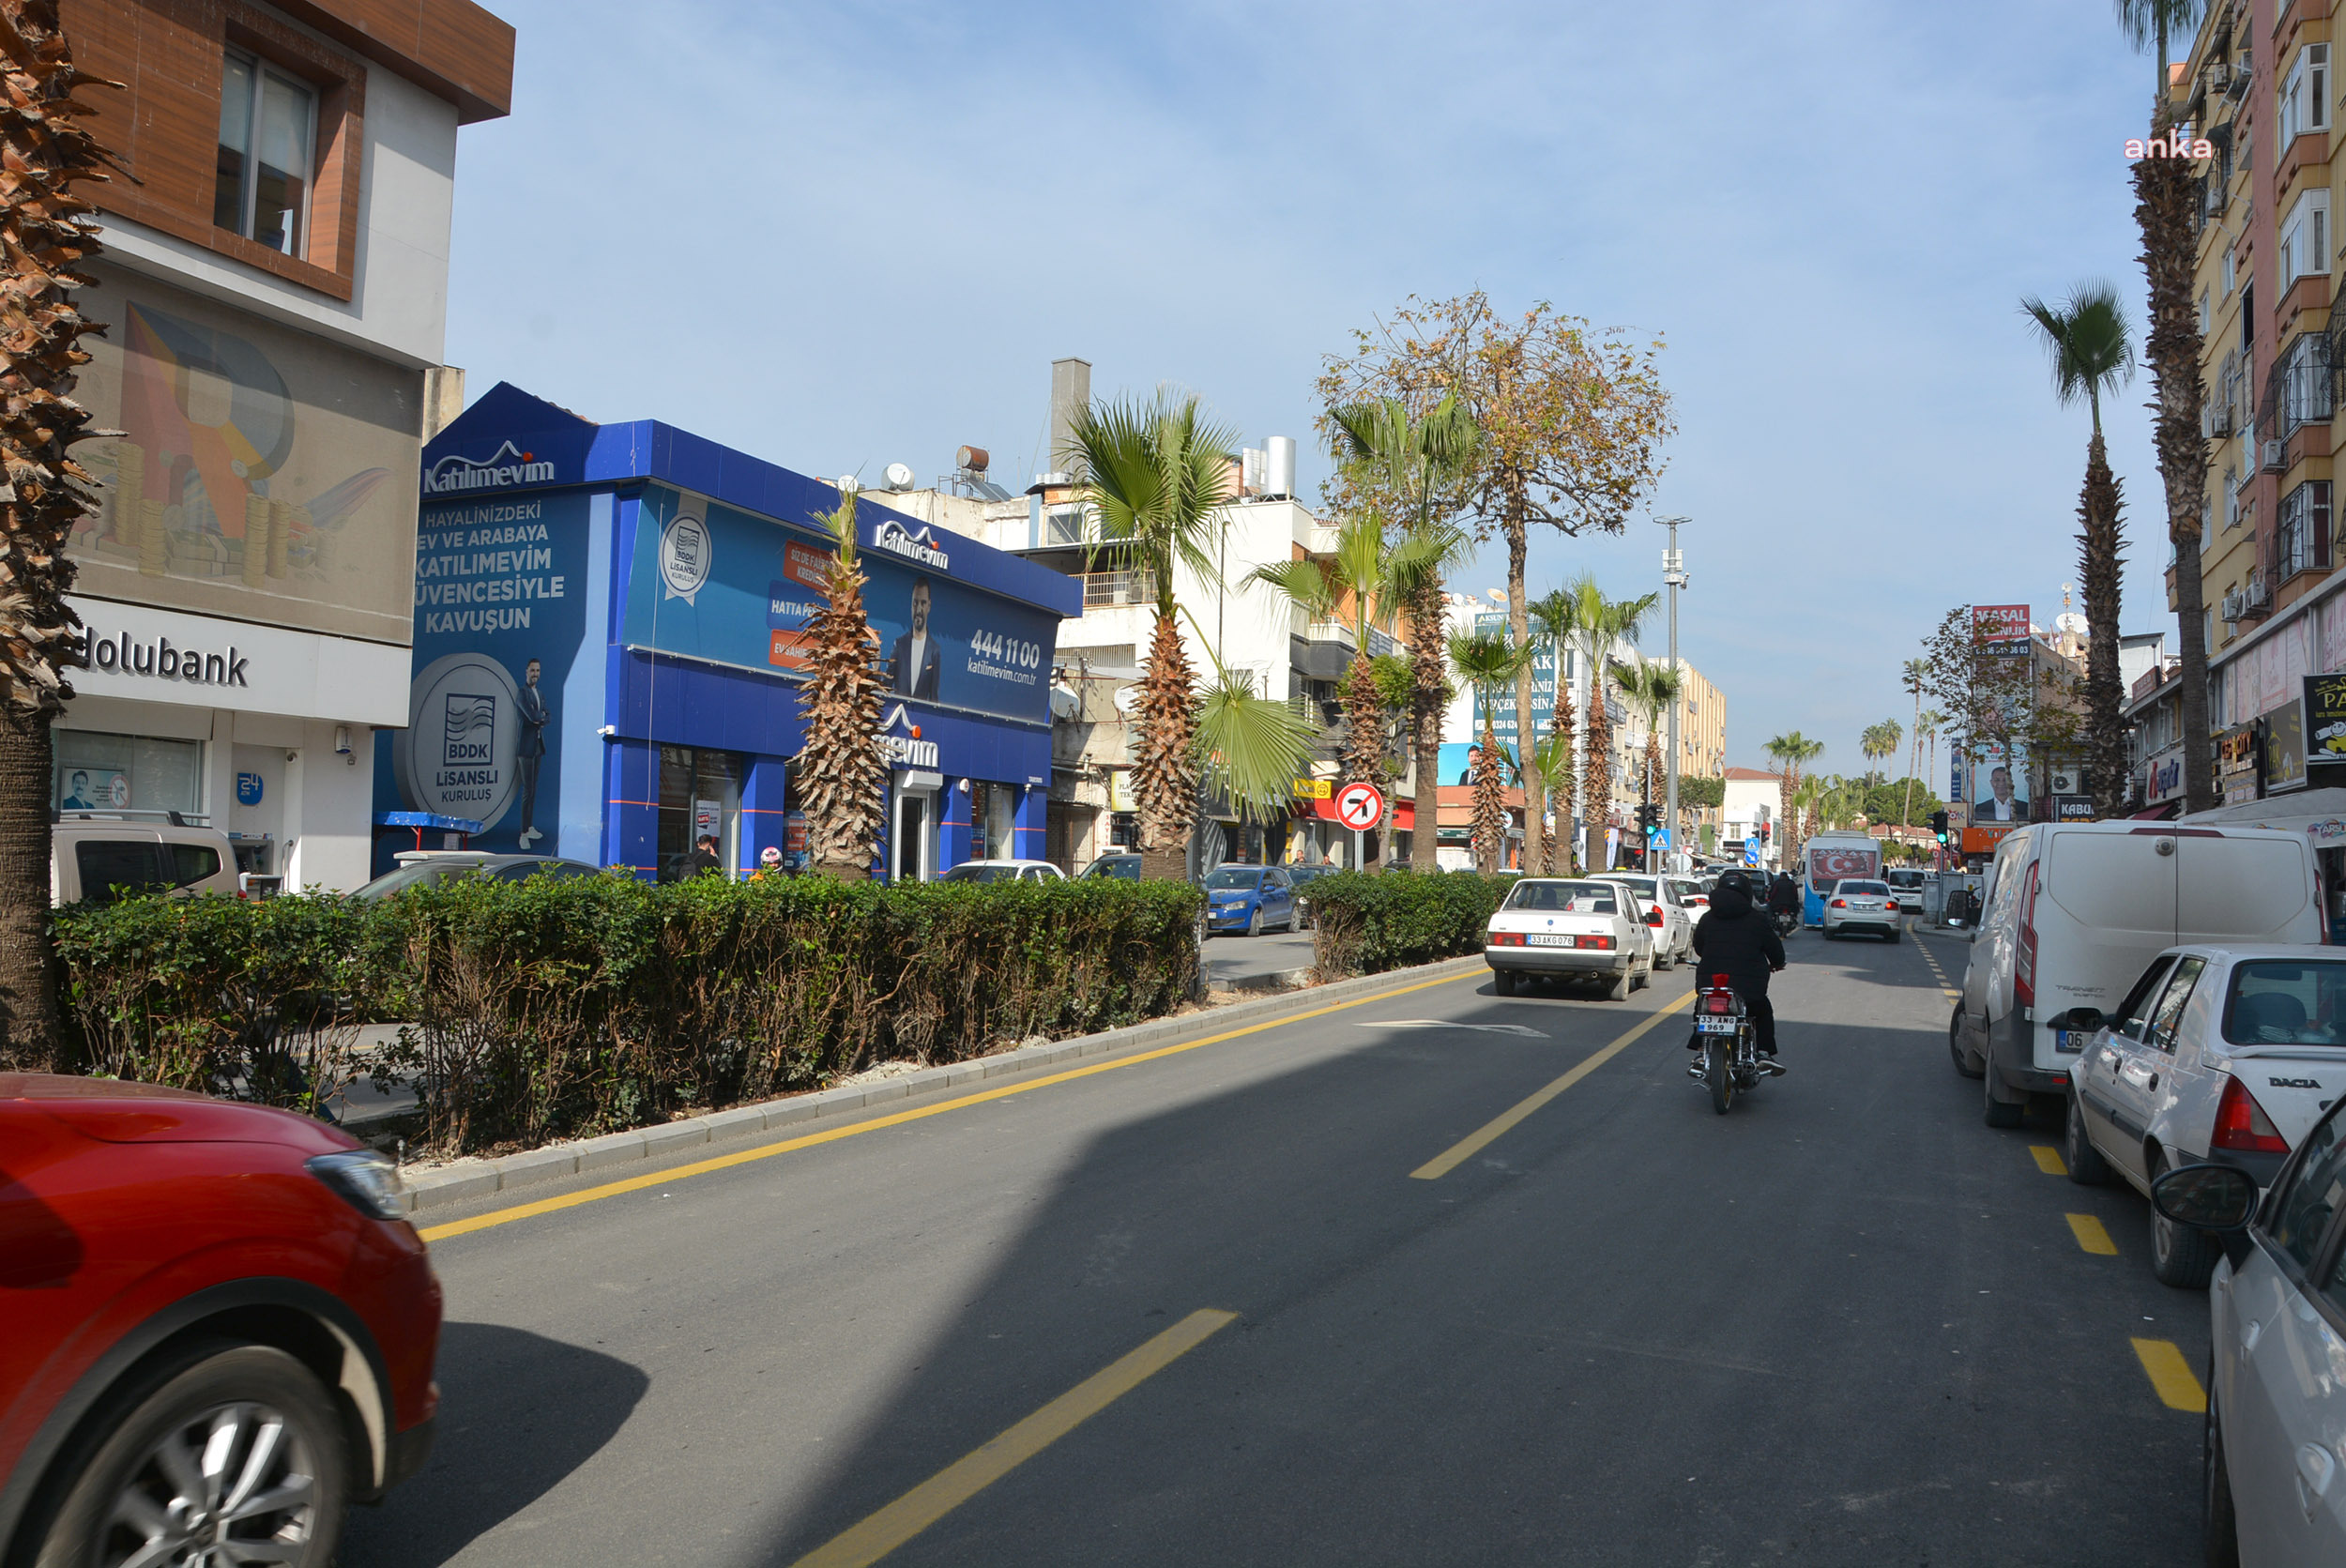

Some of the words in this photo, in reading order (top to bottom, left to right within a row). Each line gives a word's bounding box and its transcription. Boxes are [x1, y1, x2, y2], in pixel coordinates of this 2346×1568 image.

[425, 500, 541, 528] HAYALİNİZDEKİ
[417, 534, 438, 551] EV
[442, 531, 465, 549] VE
[467, 524, 549, 547] ARABAYA
[414, 573, 565, 607] ÜVENCESİYLE
[771, 599, 801, 617] HATTA
[425, 607, 531, 634] KAVUŞUN
[970, 629, 1003, 662] 444
[967, 657, 1037, 687] katilimevim.com.tr
[449, 743, 489, 759] BDDK
[441, 788, 493, 802] KURULUŞ
[1531, 936, 1542, 944] 33
[1558, 936, 1573, 945] 076
[2066, 1032, 2083, 1047] 06
[2269, 1077, 2323, 1089] DACIA
